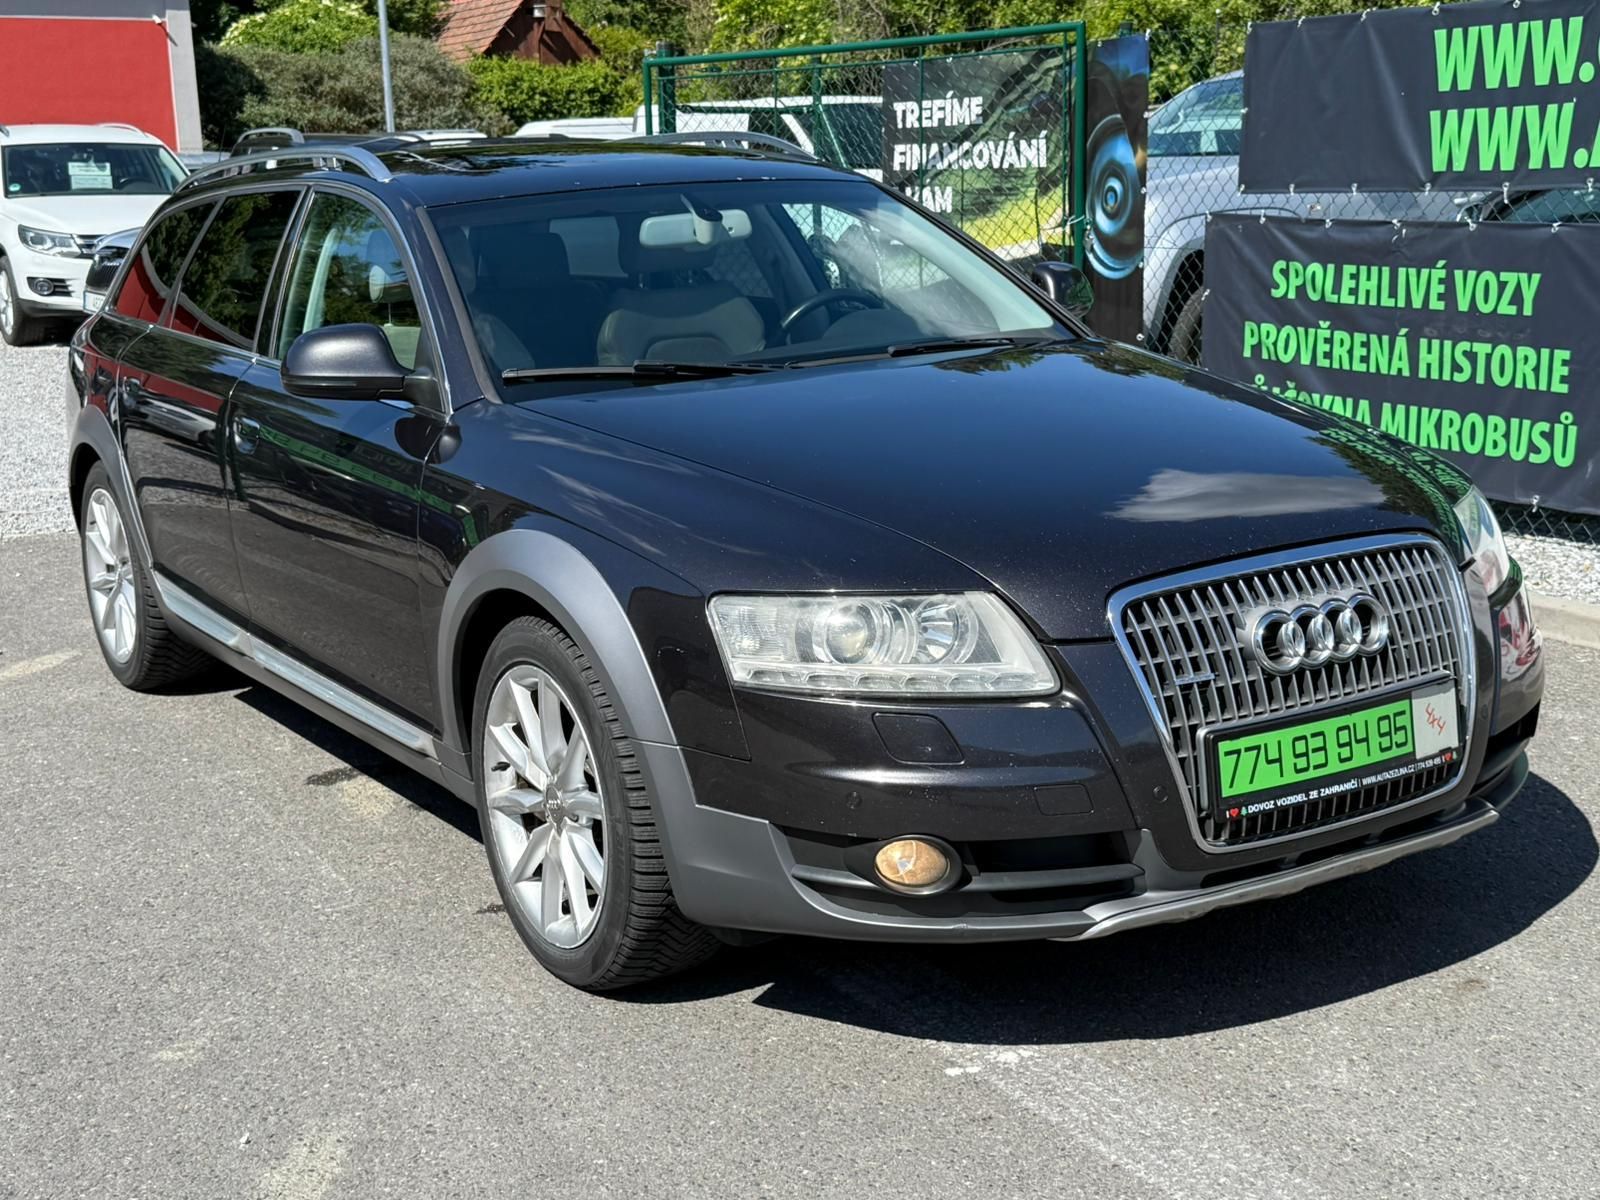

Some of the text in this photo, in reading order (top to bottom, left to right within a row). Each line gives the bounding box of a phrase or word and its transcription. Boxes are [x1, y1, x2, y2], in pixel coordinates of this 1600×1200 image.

[1434, 16, 1600, 93] WWW.
[893, 91, 983, 128] TREFÍME
[893, 130, 1048, 171] FINANCOVÁNÍ
[1270, 260, 1541, 316] SPOLEHLIVÉ VOZY
[1242, 320, 1571, 394] PROVĚRENÁ HISTORIE
[1380, 402, 1578, 468] MIKROBUSŮ
[1224, 710, 1408, 788] 774 93 94 95
[1248, 801, 1275, 813] DOVOZ
[1276, 792, 1308, 806] VOZIDEL
[1309, 790, 1319, 800] ZE
[1320, 778, 1358, 796] ZAHRANIČÍ
